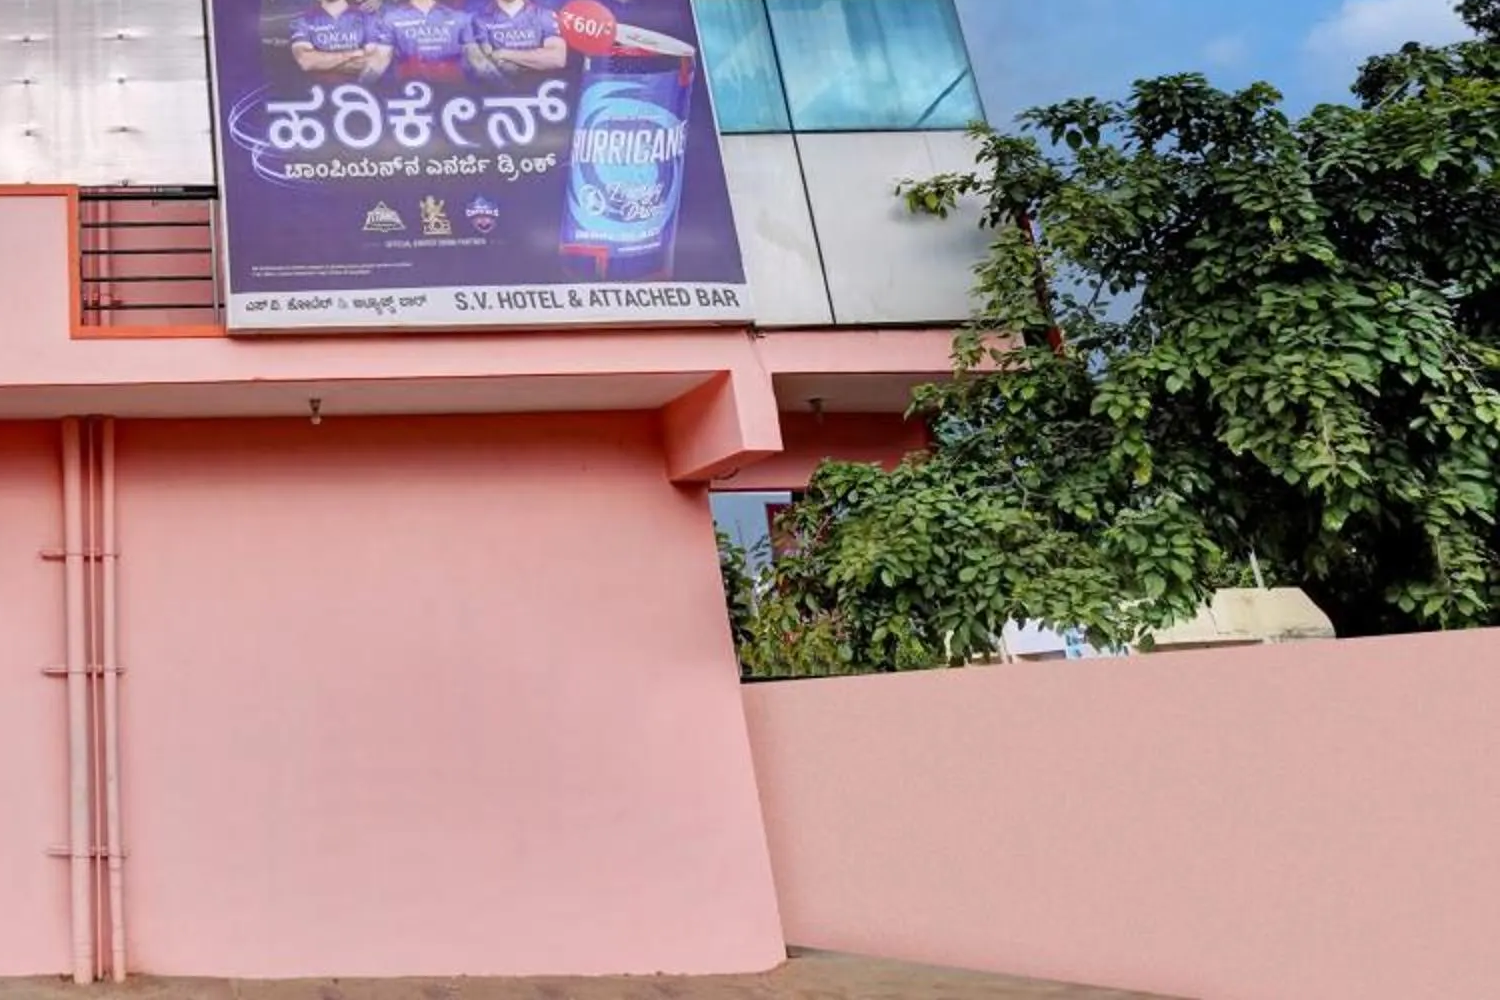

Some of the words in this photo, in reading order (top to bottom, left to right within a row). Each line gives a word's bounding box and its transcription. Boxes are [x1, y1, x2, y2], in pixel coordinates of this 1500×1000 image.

[266, 78, 568, 149] ಹರಿಕೇನ್
[454, 291, 493, 310] S.V.
[498, 290, 564, 309] HOTEL
[568, 289, 583, 306] &
[589, 288, 691, 308] ATTACHED
[697, 288, 740, 307] BAR
